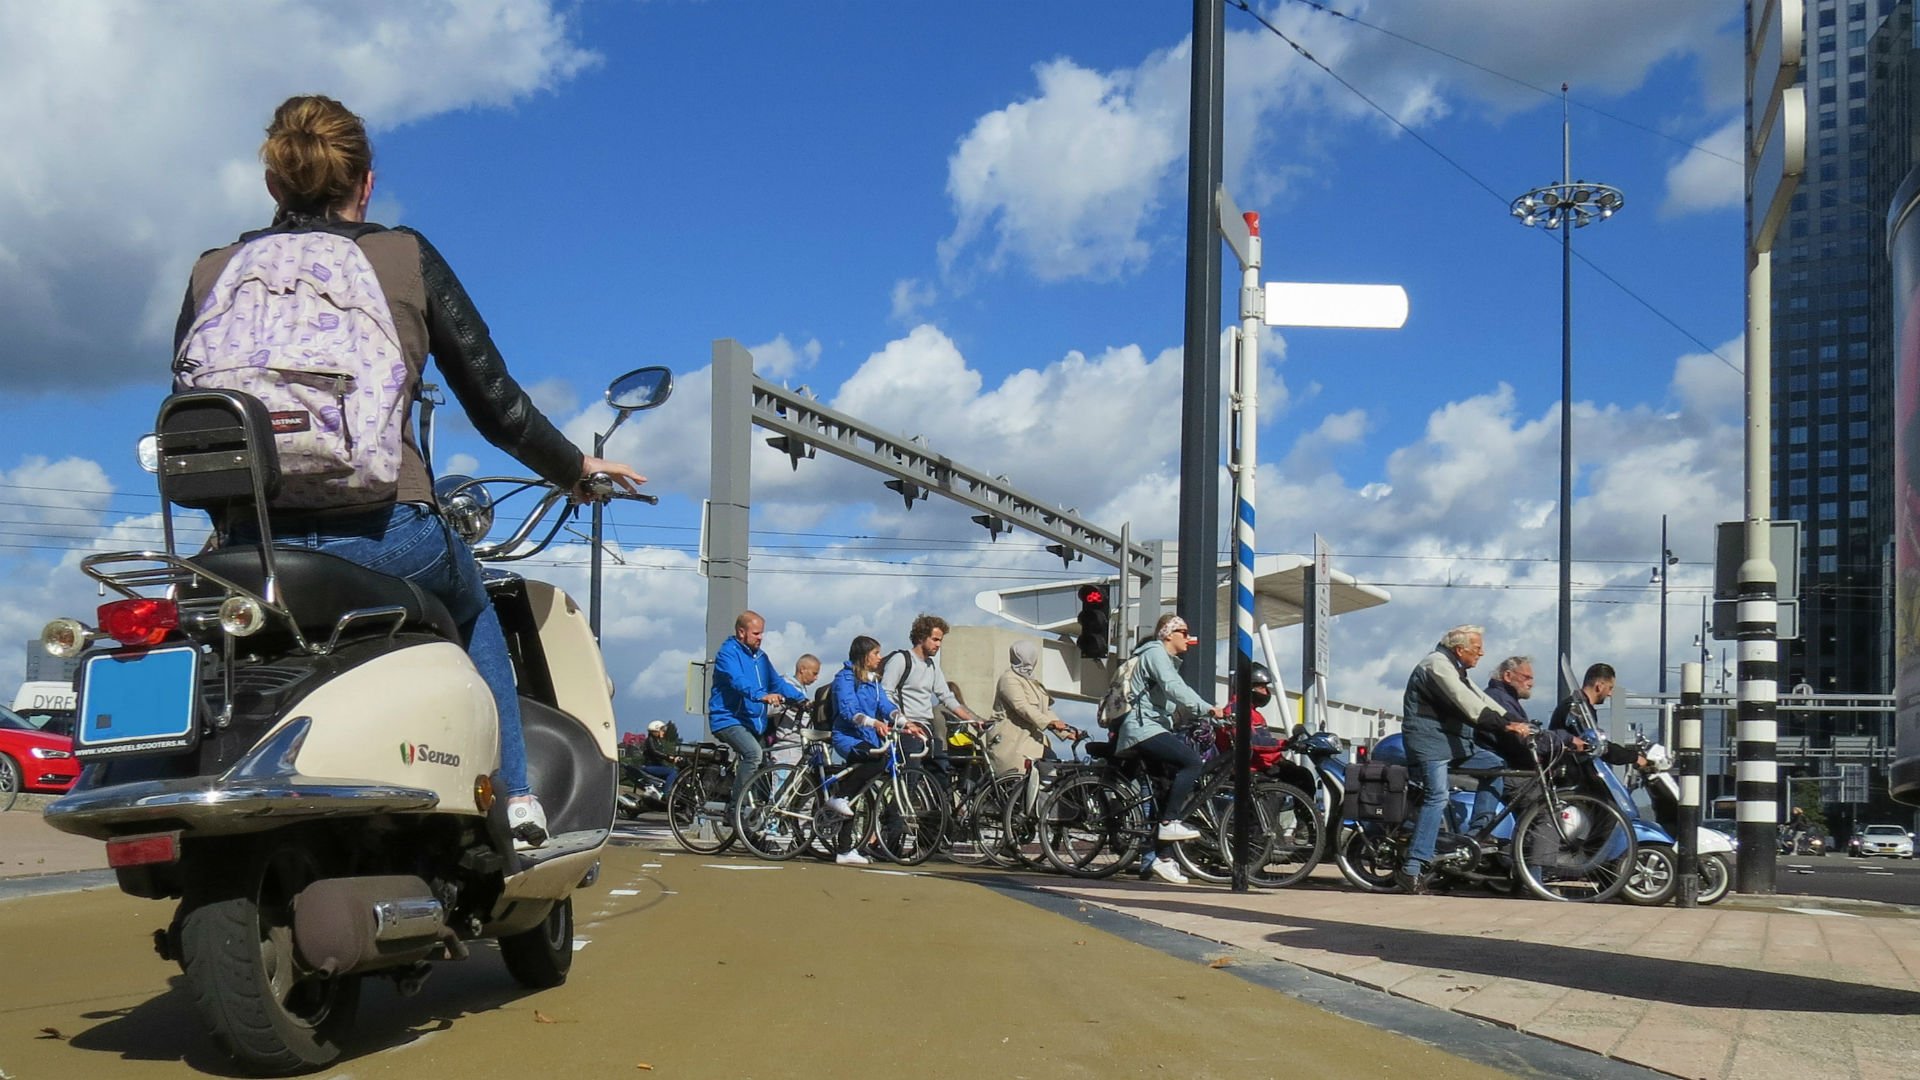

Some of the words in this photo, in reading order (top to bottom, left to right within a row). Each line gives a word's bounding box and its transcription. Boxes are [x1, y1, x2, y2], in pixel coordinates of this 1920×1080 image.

[271, 417, 303, 426] ASTPAK
[74, 740, 188, 756] WWW.VOORDEELSCOOTERS.NL
[417, 743, 461, 767] Senzo
